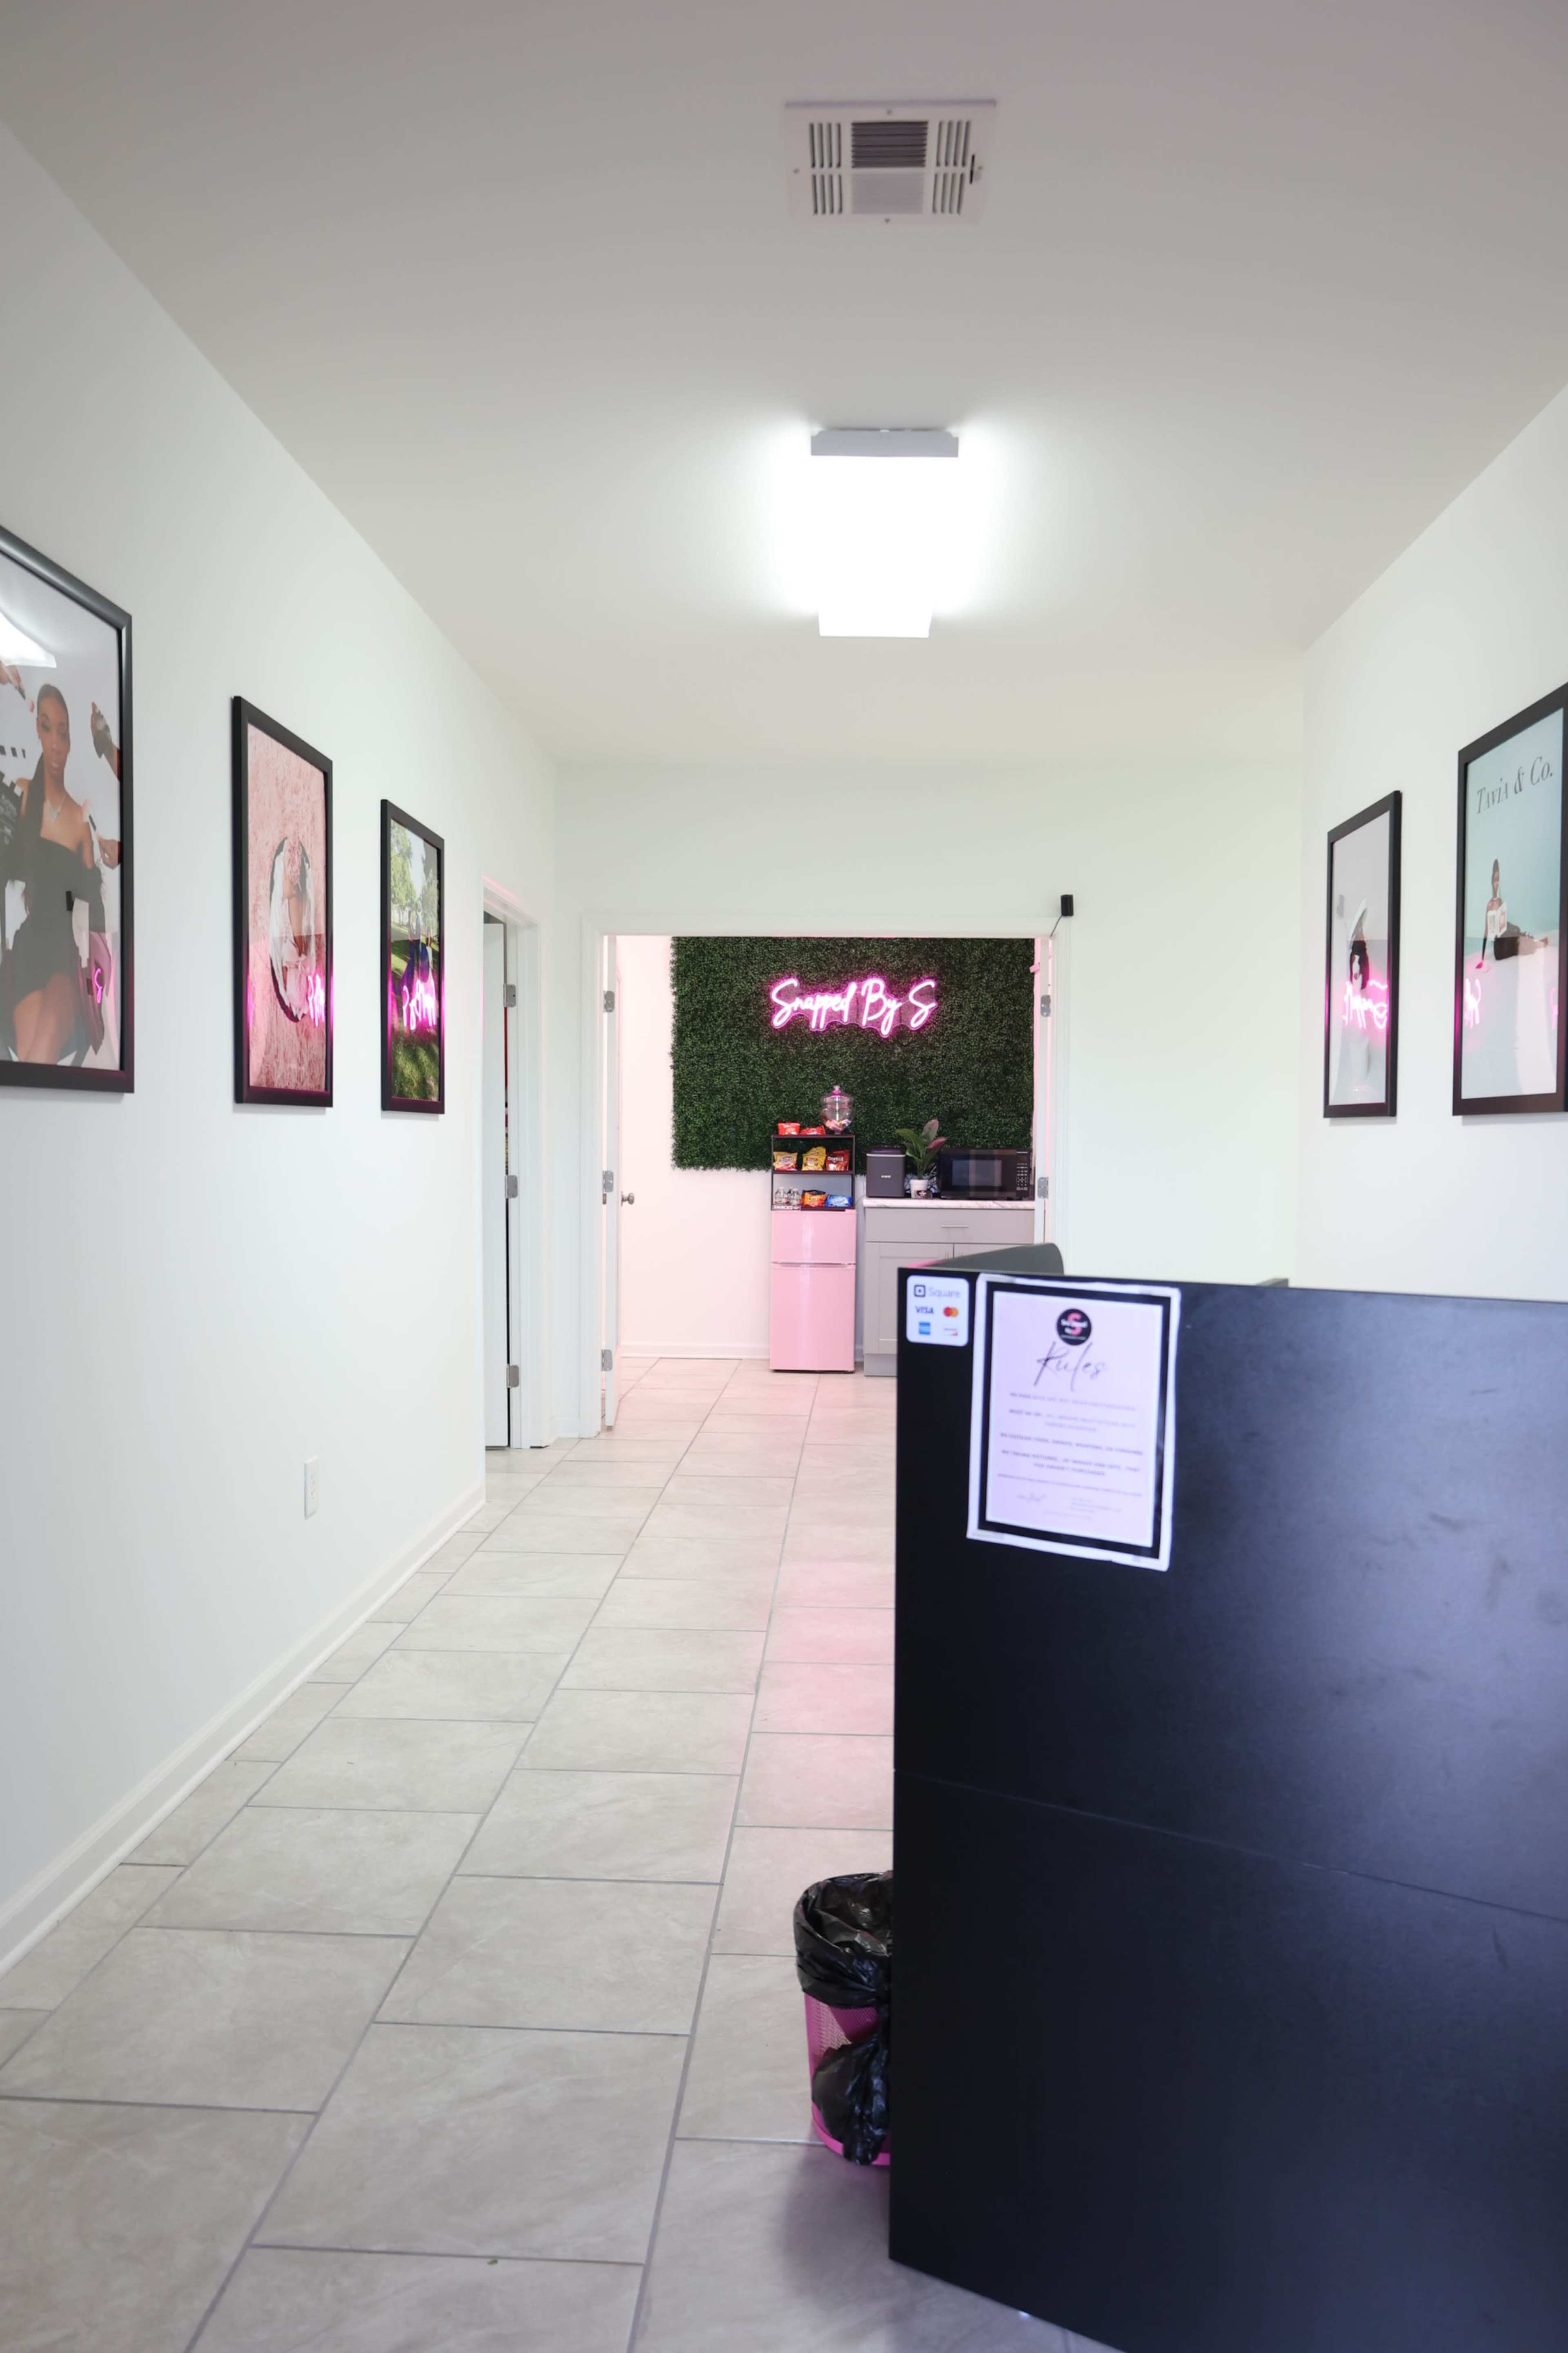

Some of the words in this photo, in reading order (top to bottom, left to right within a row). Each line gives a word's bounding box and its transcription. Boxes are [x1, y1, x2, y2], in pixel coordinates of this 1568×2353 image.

[1514, 766, 1525, 794] &
[1530, 756, 1553, 786] Co.
[771, 978, 858, 1030] Snapped
[861, 978, 903, 1037] By
[908, 979, 937, 1029] S
[915, 1306, 934, 1315] VISA
[928, 1287, 961, 1299] Square
[1033, 1341, 1106, 1392] Rules
